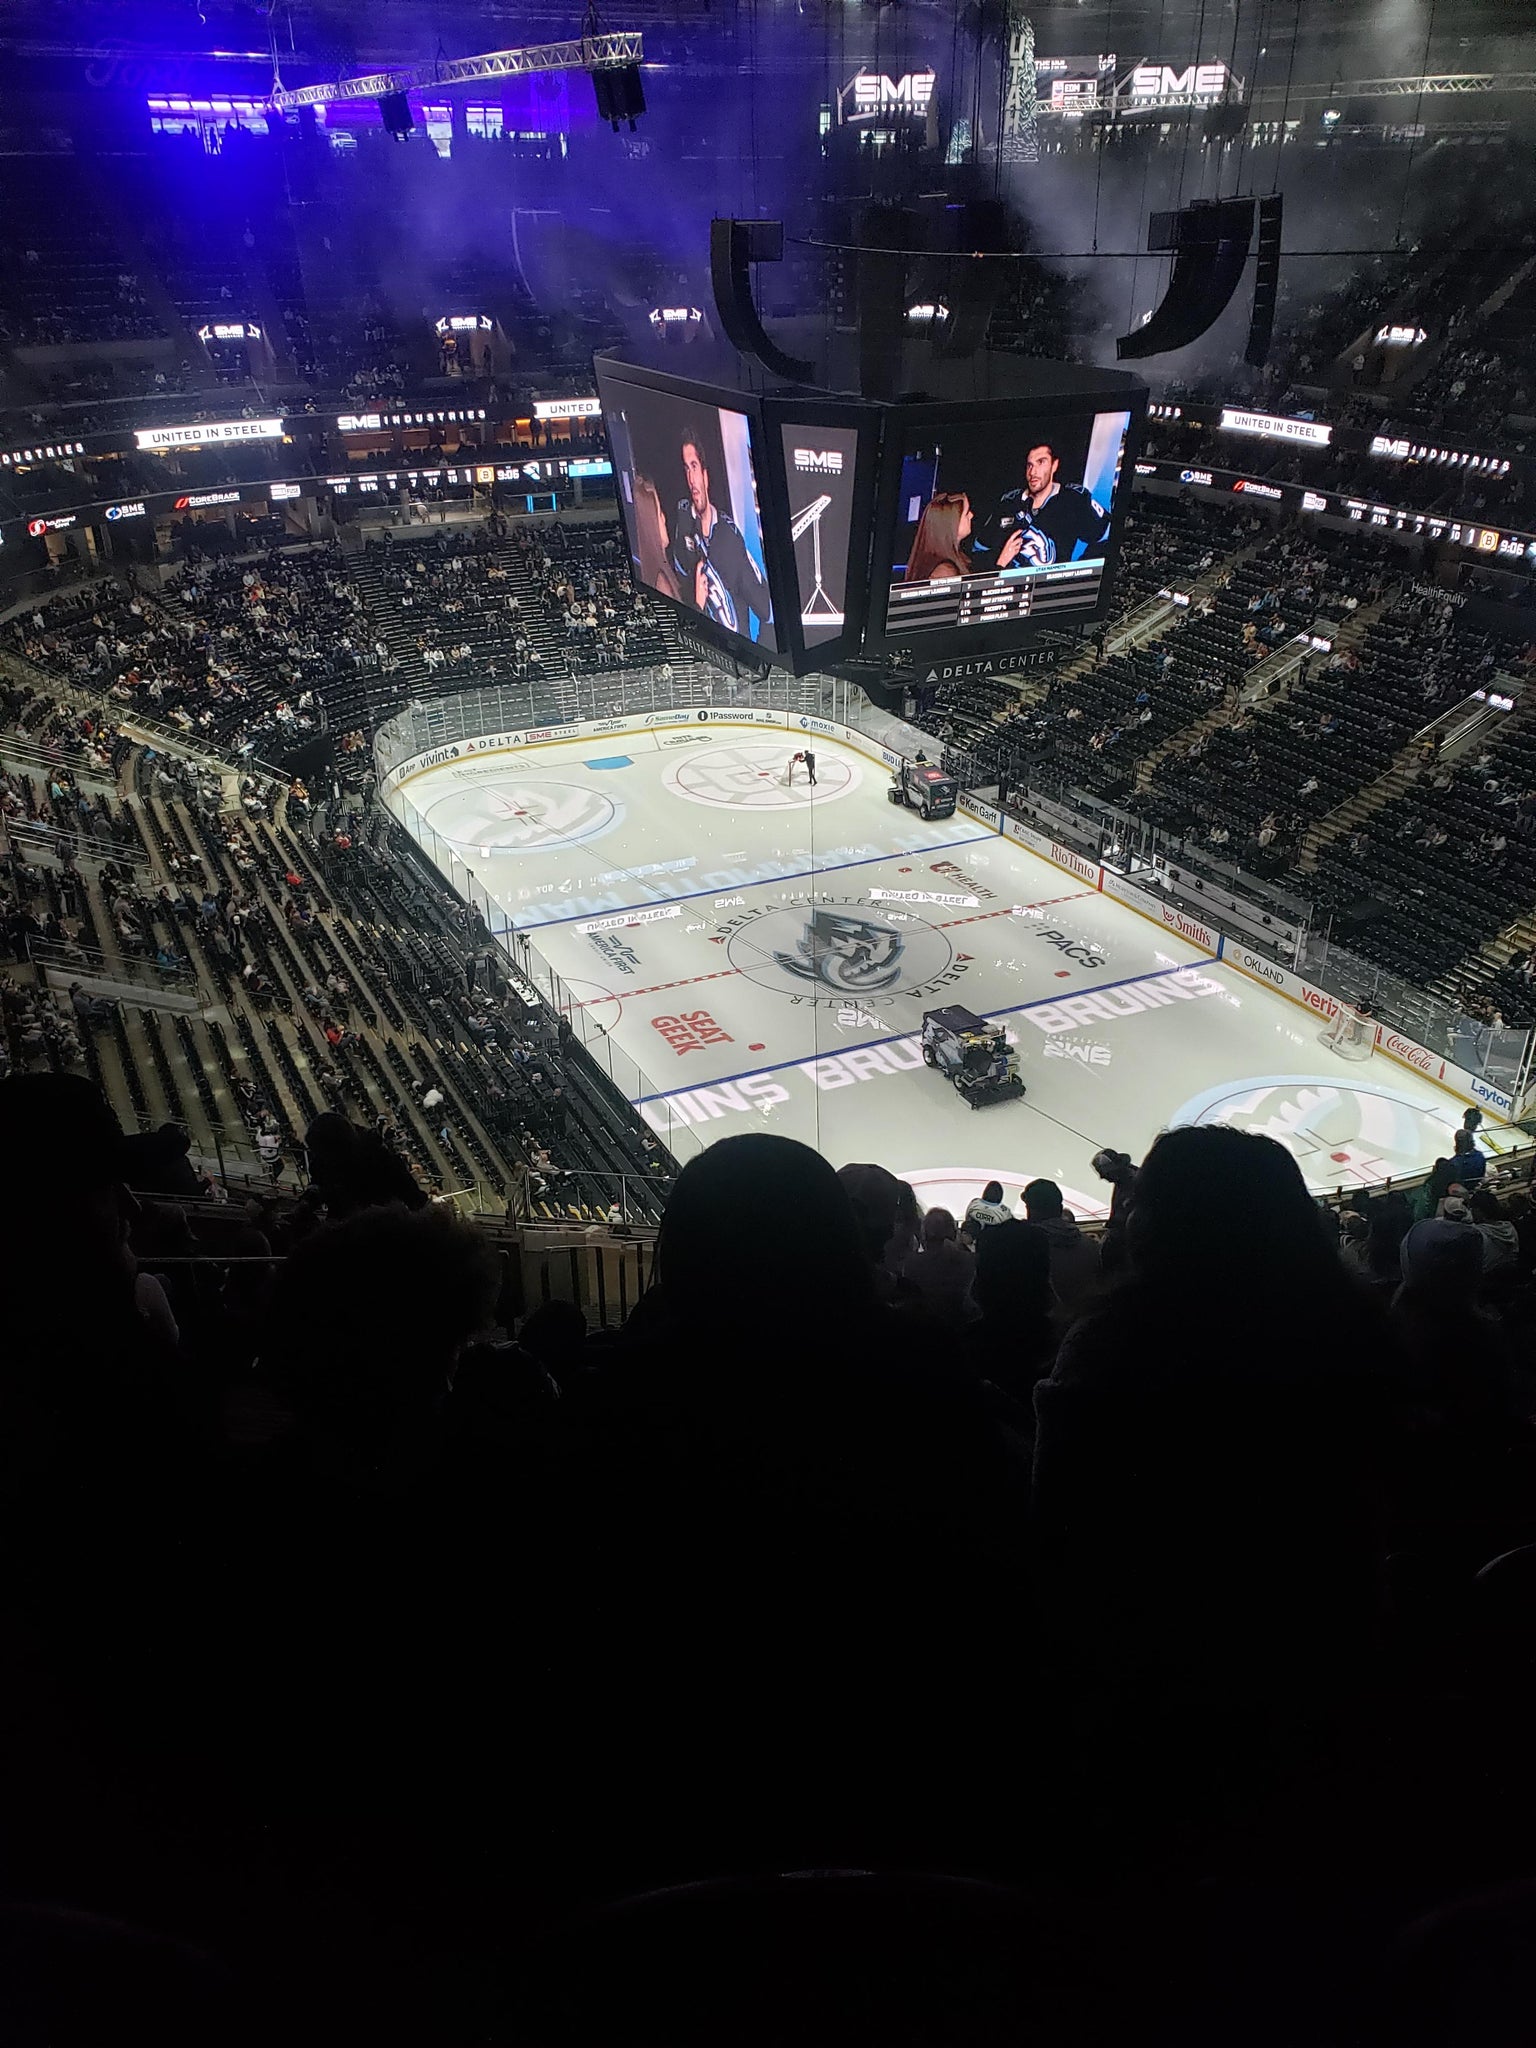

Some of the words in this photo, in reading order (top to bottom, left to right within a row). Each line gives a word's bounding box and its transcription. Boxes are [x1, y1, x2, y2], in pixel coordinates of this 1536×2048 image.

[855, 74, 936, 101] SME
[1132, 65, 1226, 95] SME
[858, 103, 926, 112] INDUSTRIE
[337, 414, 381, 430] SME
[384, 409, 486, 425] INDUSTRIES
[551, 403, 593, 414] UNITED
[152, 430, 201, 443] UNITED
[206, 428, 219, 439] IN
[224, 424, 267, 437] STEEL
[1234, 416, 1270, 431] UNITED
[1273, 421, 1283, 432] IN
[1286, 423, 1317, 438] STEEL
[2, 442, 84, 464] DUSTRIES
[794, 449, 842, 469] SME
[1372, 436, 1410, 457] SME
[1410, 445, 1511, 472] INDUSTRIES
[497, 468, 520, 480] 9:06
[121, 503, 145, 513] SME
[1500, 539, 1524, 555] 9:06
[1412, 581, 1468, 607] HealthEquity
[683, 635, 707, 657] DELTA
[942, 660, 994, 680] DELTA
[999, 651, 1056, 670] CENTER
[709, 711, 754, 720] 1Password
[811, 720, 835, 733] moxie
[479, 735, 522, 749] DELTA
[529, 731, 552, 741] SME
[554, 728, 576, 737] STEEL
[420, 748, 448, 769] vivint
[883, 752, 895, 765] BUD
[965, 798, 979, 812] Ken
[979, 806, 997, 824] Garff
[952, 873, 999, 900] HEALTH
[716, 904, 779, 935] DELTA
[790, 896, 882, 908] CENTER
[1175, 913, 1211, 947] Smith's
[587, 932, 617, 958] AMERICA
[610, 957, 635, 975] FIRST
[1036, 930, 1106, 969] PACS
[905, 963, 969, 999] DELTA
[1243, 954, 1284, 985] OKLAND
[790, 995, 894, 1009] CENTER
[1020, 967, 1227, 1034] BRUINS
[1302, 986, 1339, 1018] veriz
[650, 1015, 707, 1056] GEEK
[679, 1010, 735, 1044] SEAT
[1386, 1034, 1435, 1071] Coca-Cola
[1471, 1078, 1511, 1111] Layton
[975, 1211, 995, 1224] CURRY
